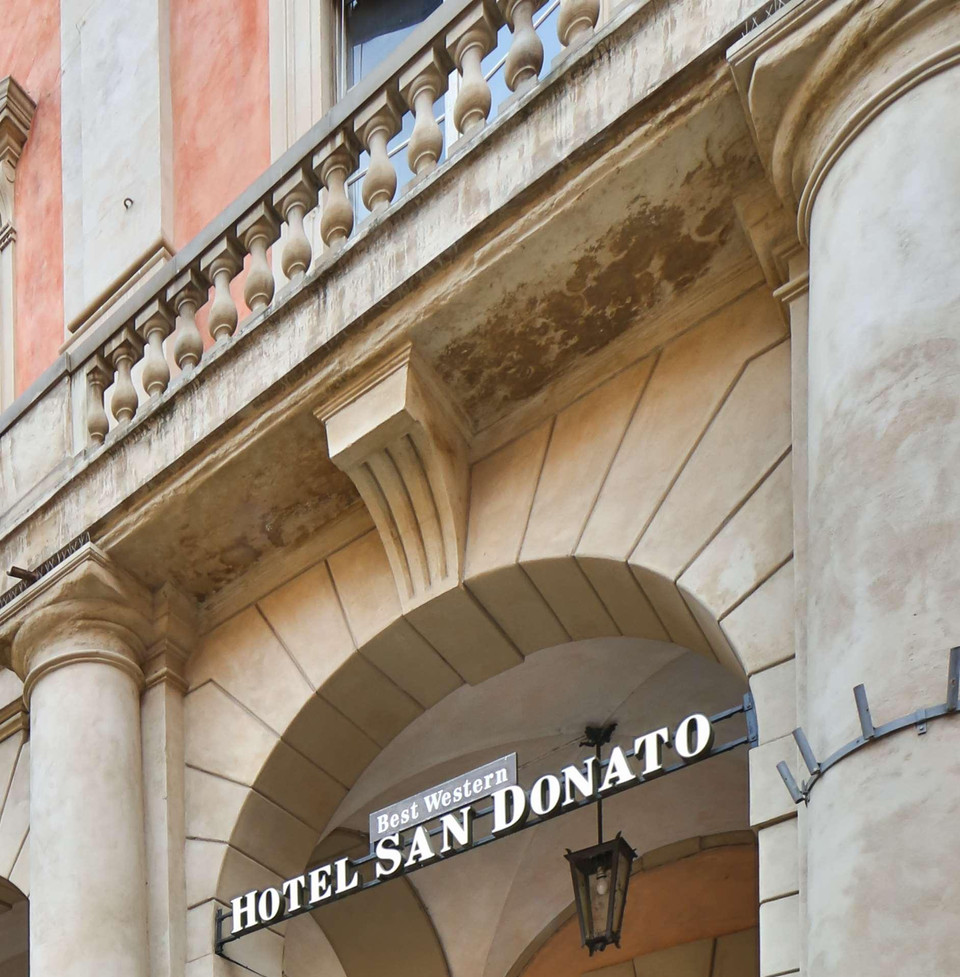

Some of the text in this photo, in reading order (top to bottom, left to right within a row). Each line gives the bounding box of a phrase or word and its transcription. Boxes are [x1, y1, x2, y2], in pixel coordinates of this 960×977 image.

[231, 713, 712, 934] HOTEL SAN DONATO
[377, 768, 509, 834] Best Western
